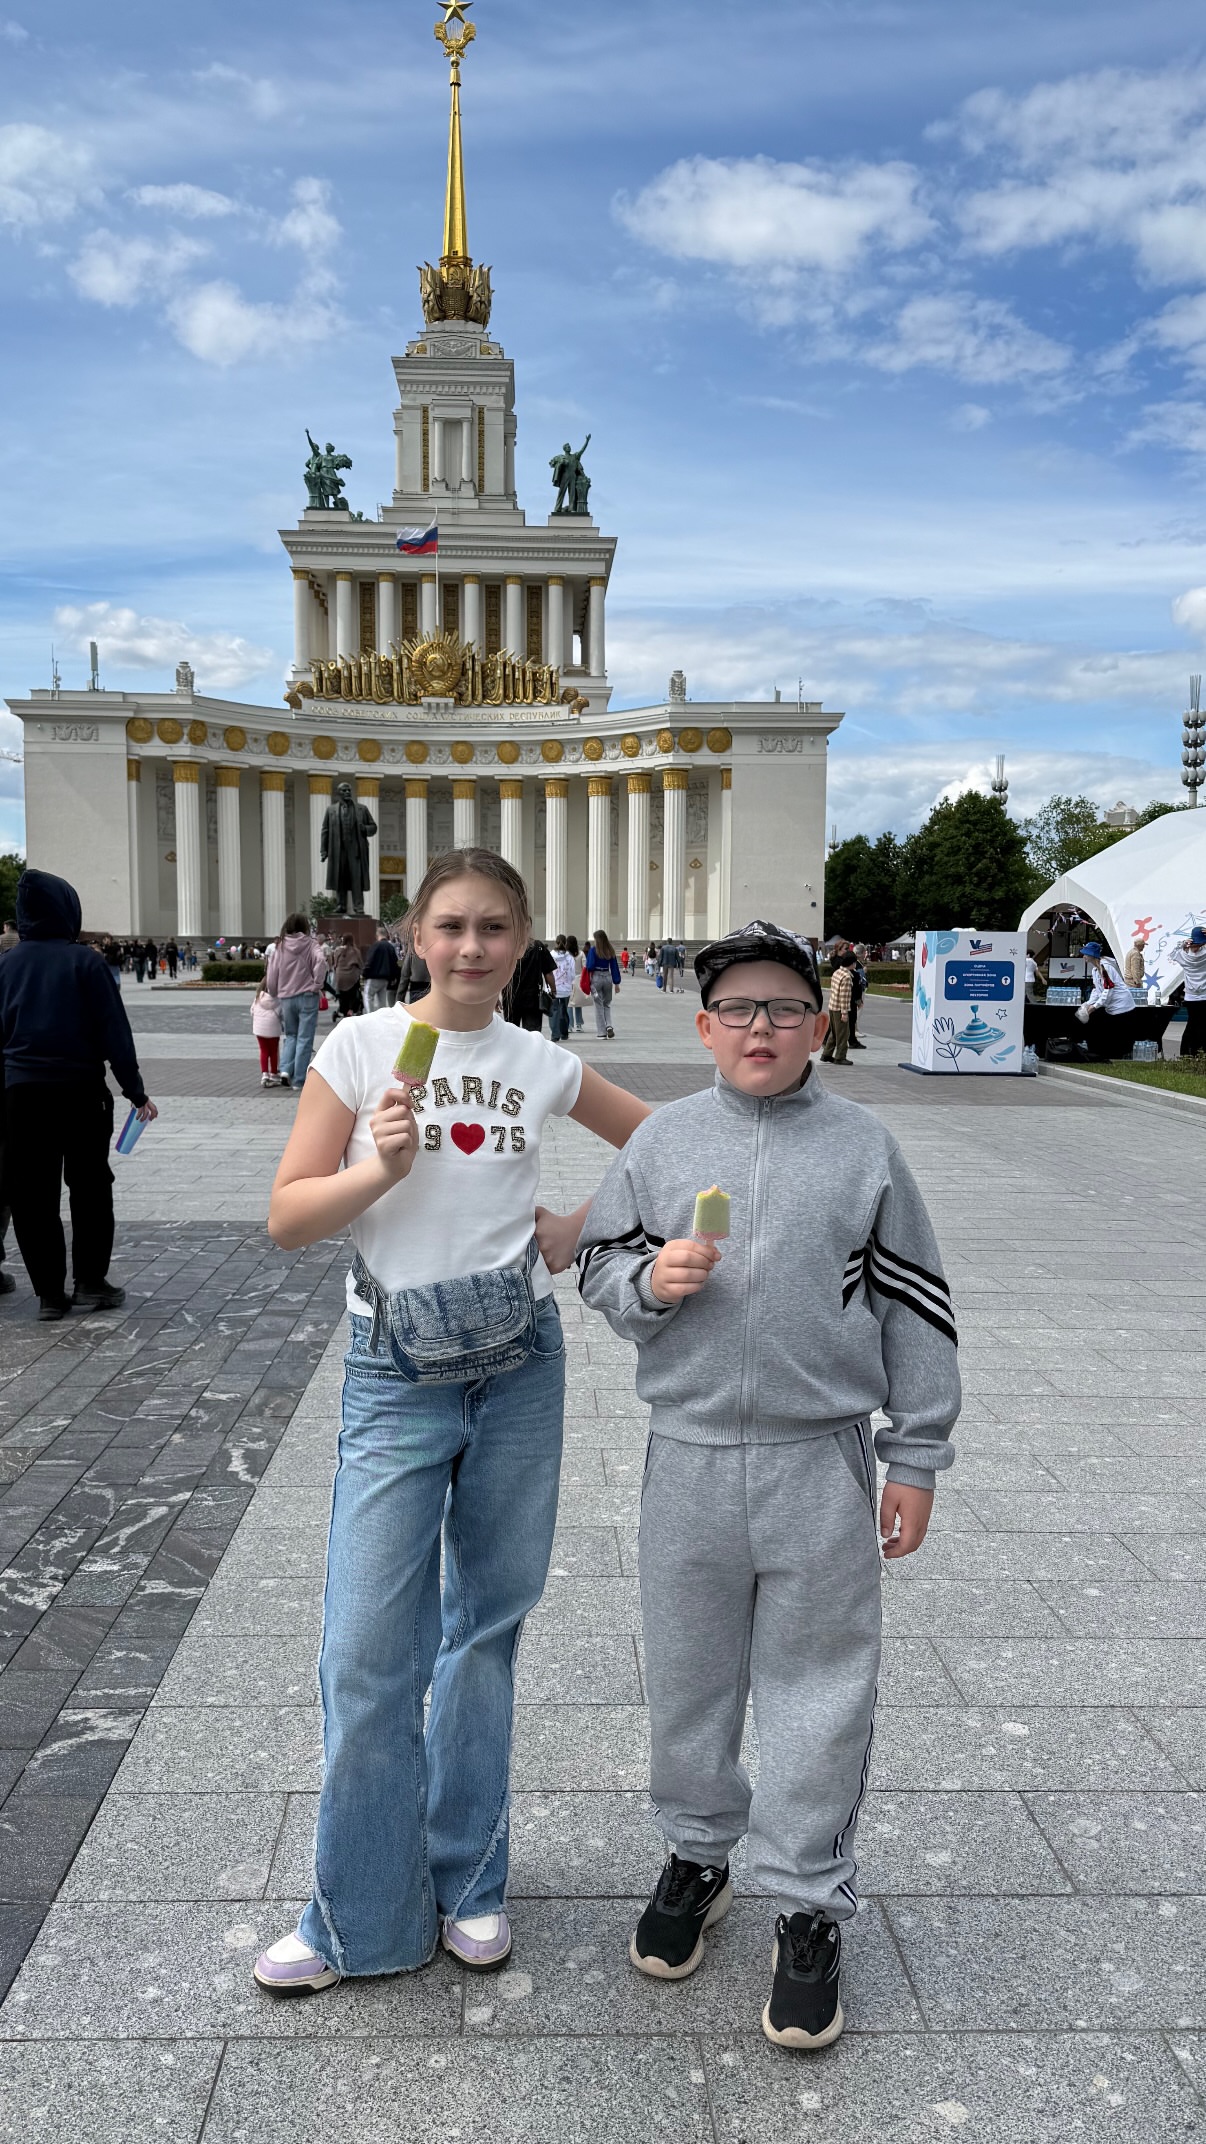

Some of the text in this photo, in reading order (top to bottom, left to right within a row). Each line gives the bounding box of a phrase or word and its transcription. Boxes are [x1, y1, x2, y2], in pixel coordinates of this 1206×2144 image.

[509, 705, 562, 721] РЕСПУБЛИК
[409, 1076, 525, 1118] PARIS
[424, 1124, 526, 1152] 9 75
